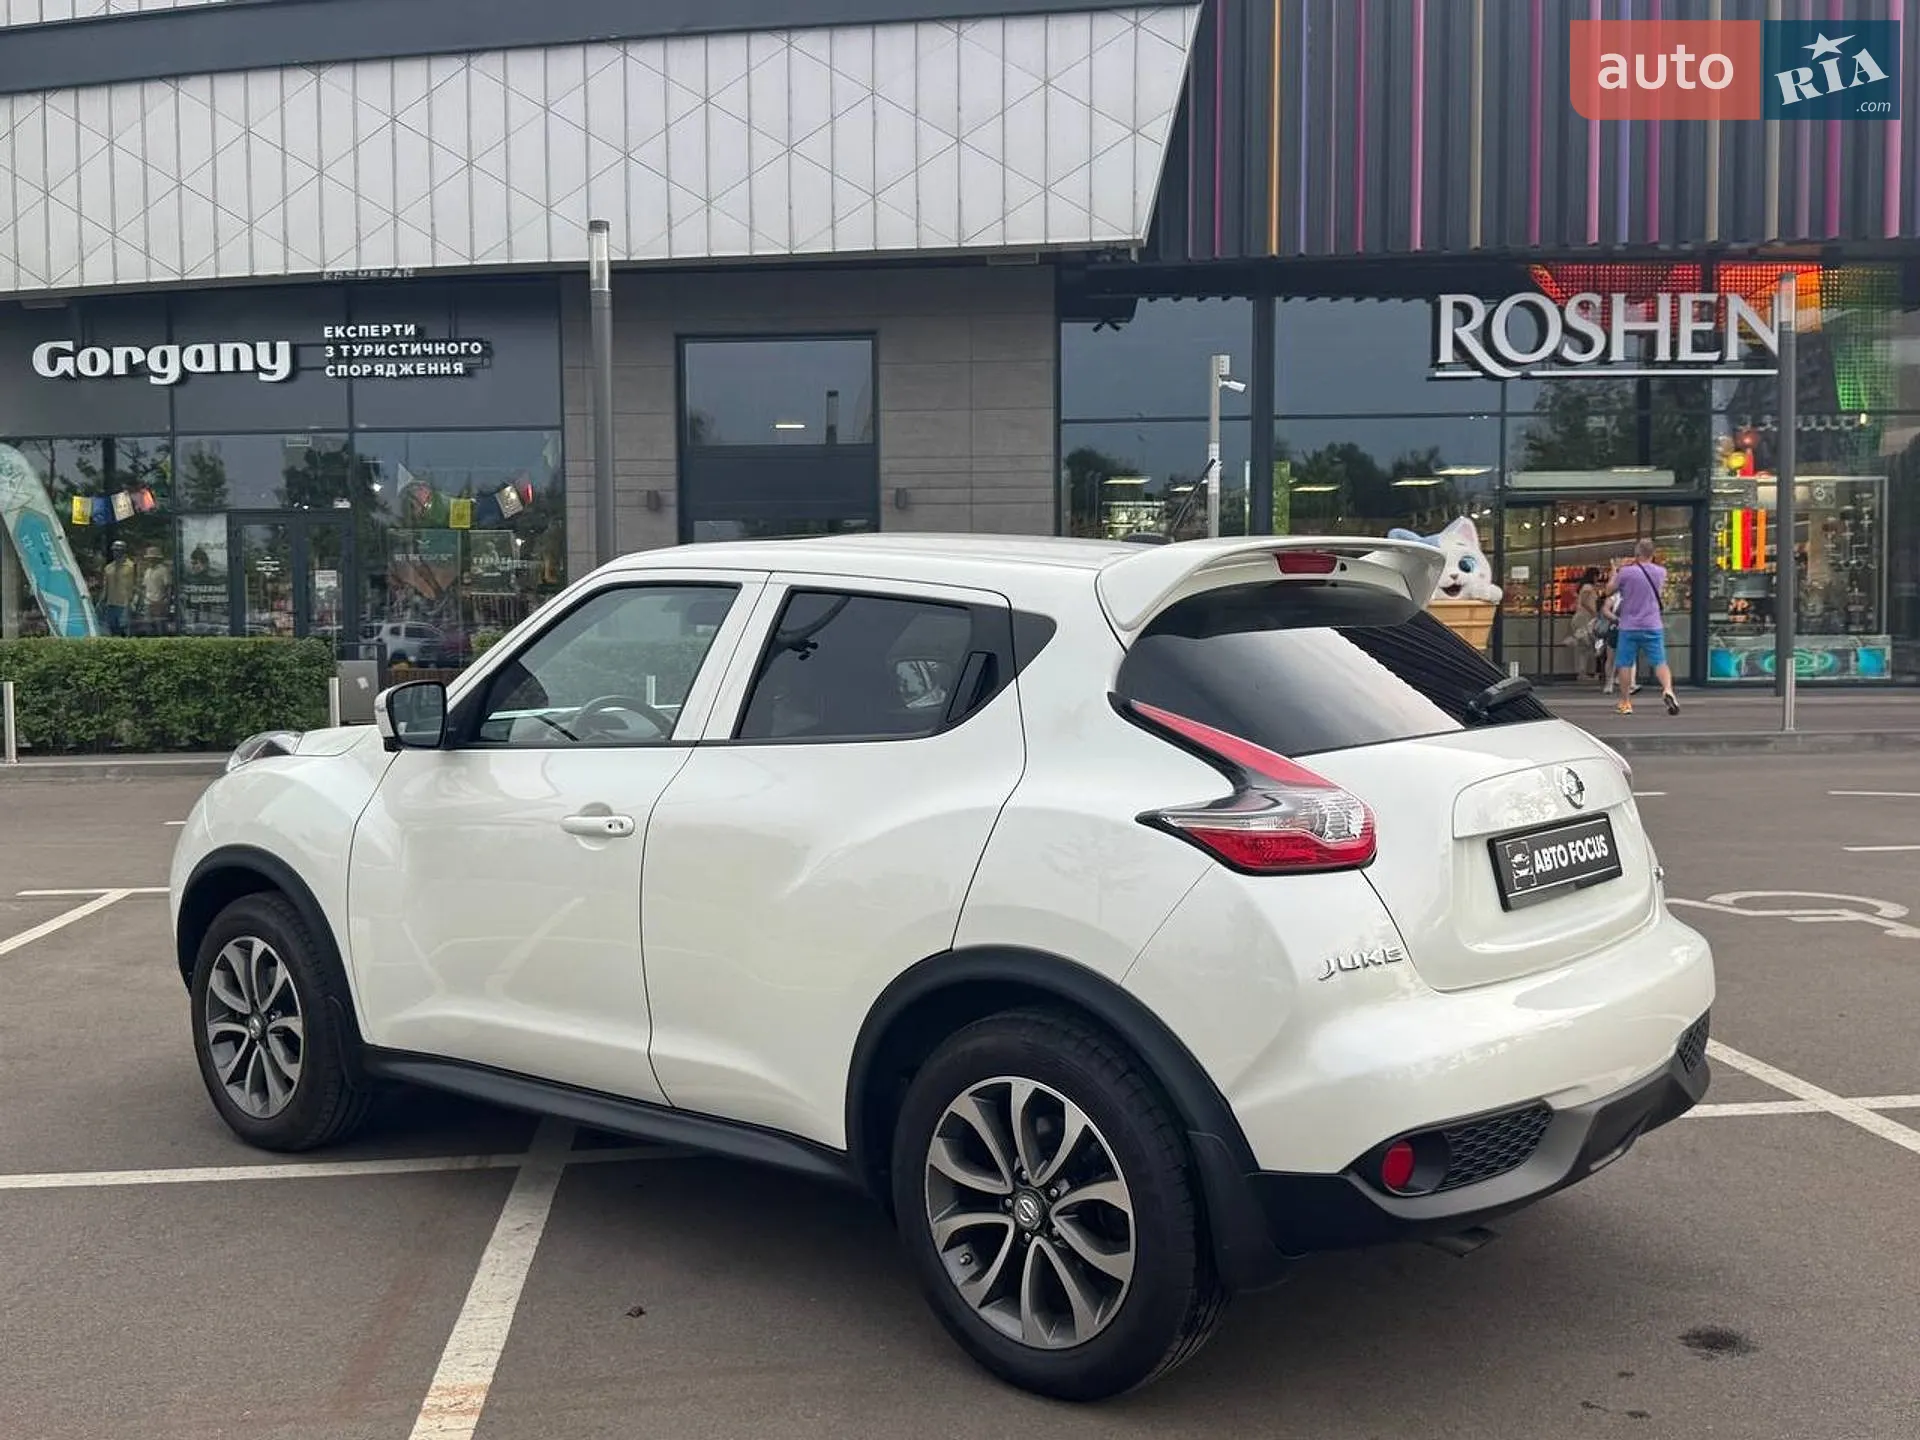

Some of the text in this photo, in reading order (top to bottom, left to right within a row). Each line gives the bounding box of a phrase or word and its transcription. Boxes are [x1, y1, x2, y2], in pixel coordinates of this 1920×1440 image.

[324, 324, 416, 338] ЕКСПЕРТИ
[1438, 292, 1779, 378] ROSHEN
[32, 340, 291, 385] Gorgany
[340, 342, 482, 357] ТУРИСТИЧНОГО
[325, 362, 464, 377] СПОРЯДЖЕННЯ
[1567, 834, 1609, 864] FOCUS
[1318, 948, 1403, 981] JUKE
